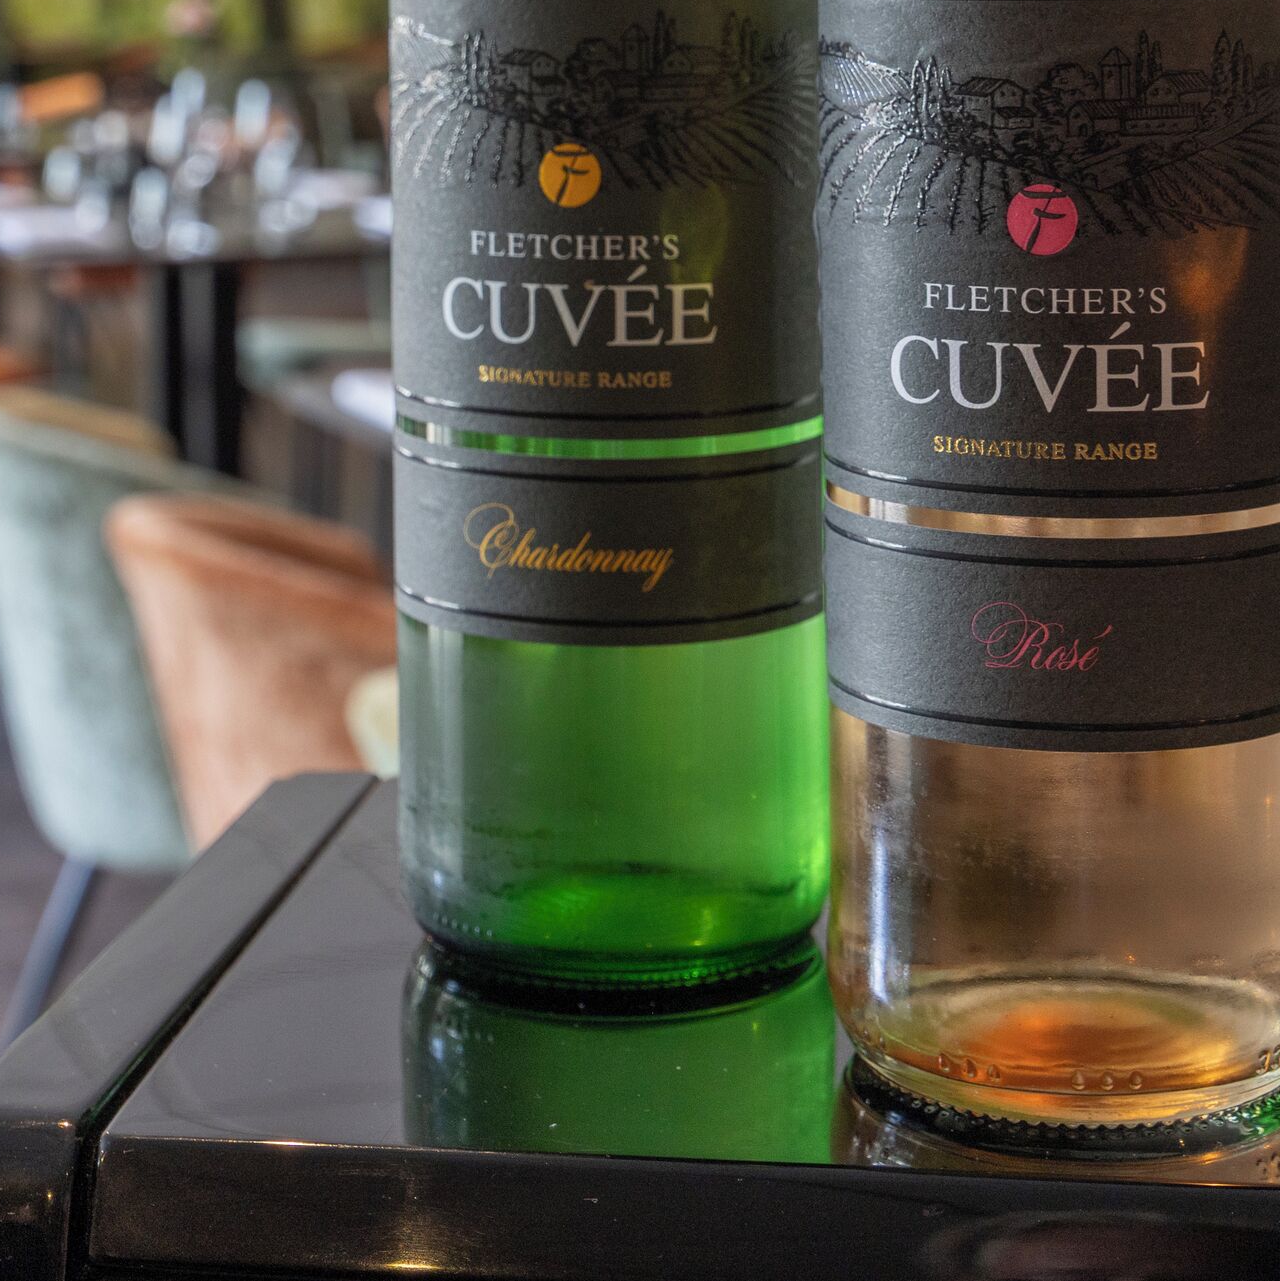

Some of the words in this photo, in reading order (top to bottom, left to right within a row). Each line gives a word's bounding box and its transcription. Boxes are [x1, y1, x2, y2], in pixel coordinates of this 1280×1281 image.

[470, 229, 680, 260] FLETCHER'S
[441, 264, 718, 348] CUVÉE
[923, 282, 1167, 315] FLETCHER'S
[478, 364, 590, 388] SIGNATURE
[598, 370, 673, 389] RANGE
[890, 321, 1210, 413] CUVÉE
[933, 435, 1066, 460] SIGNATURE
[1074, 441, 1158, 460] RANGE
[463, 502, 673, 593] Chardonnay
[971, 601, 1113, 671] Rosé
